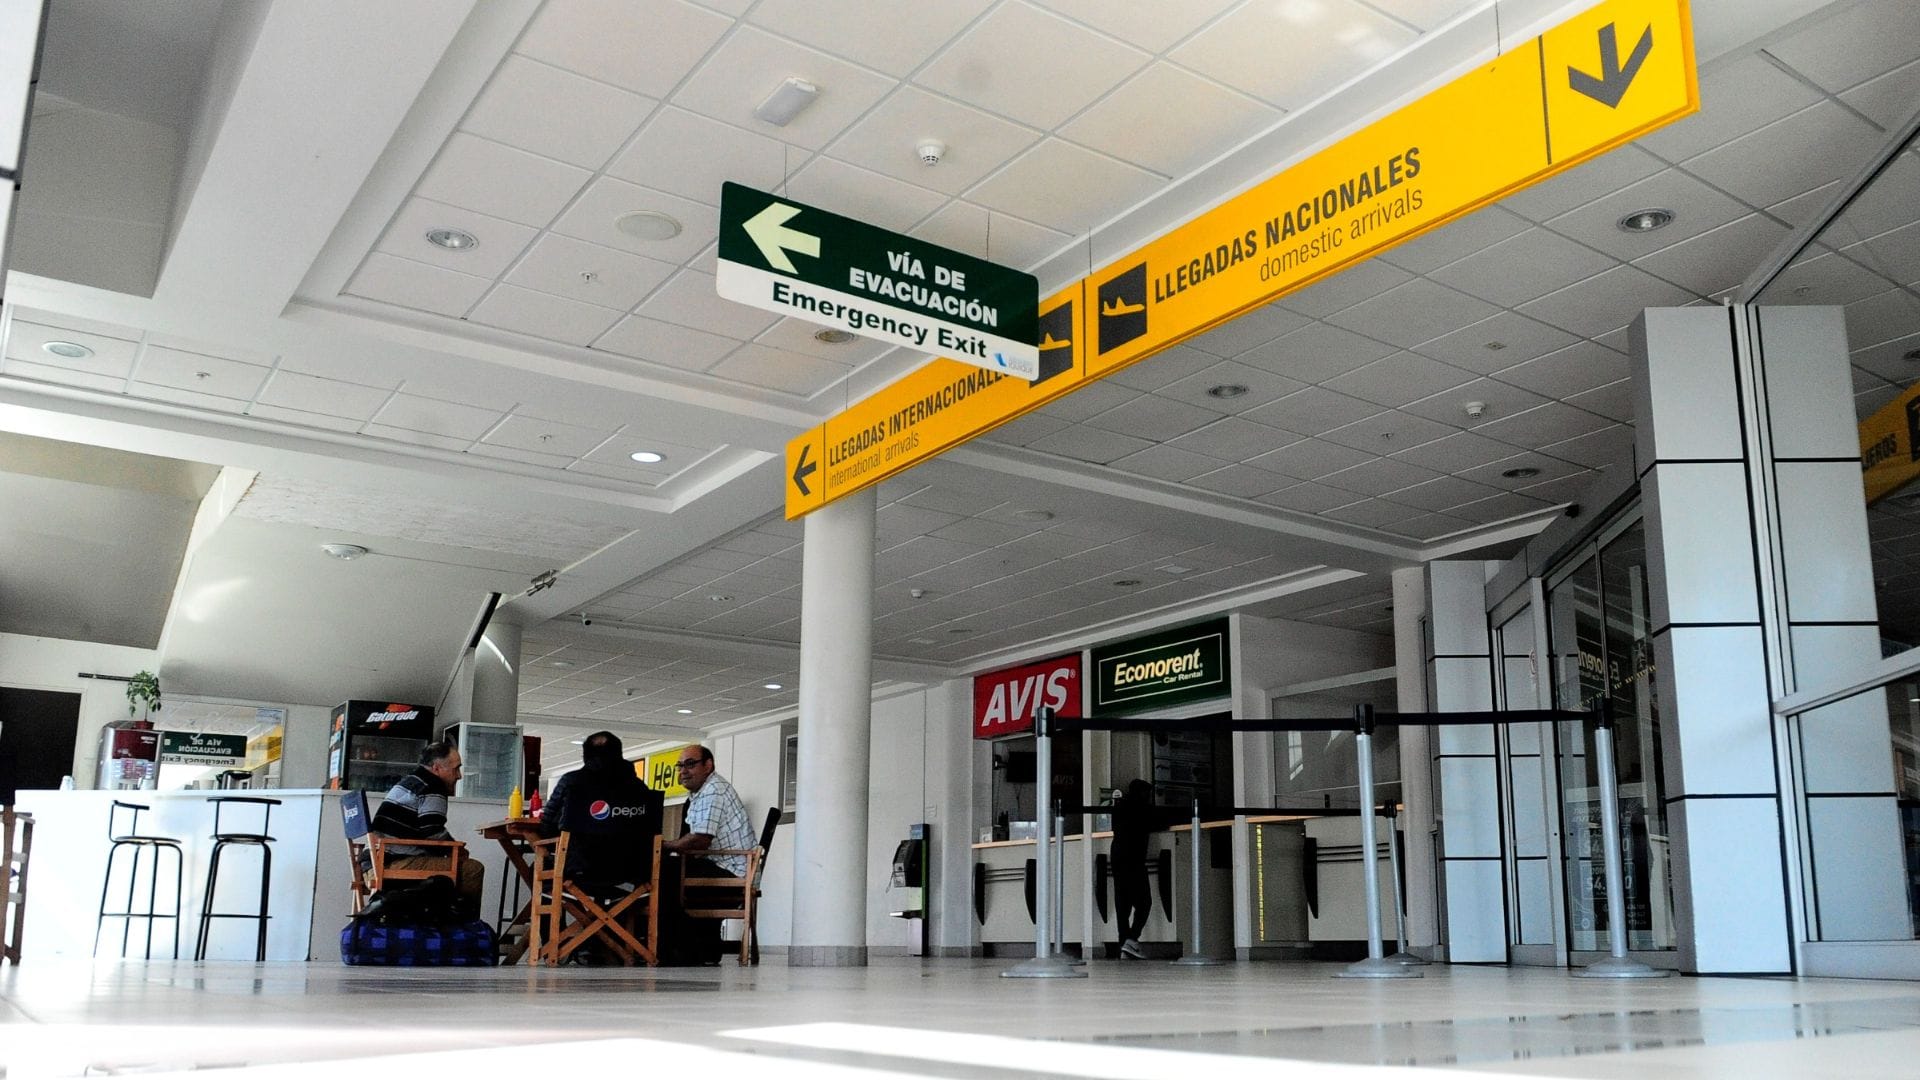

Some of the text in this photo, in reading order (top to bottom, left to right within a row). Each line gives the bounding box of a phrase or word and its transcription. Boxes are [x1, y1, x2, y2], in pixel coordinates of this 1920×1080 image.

[1154, 147, 1421, 304] LLEGADAS NACIONALES
[1260, 188, 1424, 282] domestic arrivals
[849, 266, 998, 327] EVACUACIÓN
[887, 251, 966, 292] VÍA DE
[772, 281, 987, 358] Emergency Exit
[829, 367, 1009, 467] LLEGADAS INTERNACIONALE
[829, 432, 920, 489] international arrivals
[1163, 669, 1204, 685] Car Rental
[366, 710, 419, 723] Gatorade
[653, 761, 682, 790] Her
[611, 804, 646, 818] pepsi
